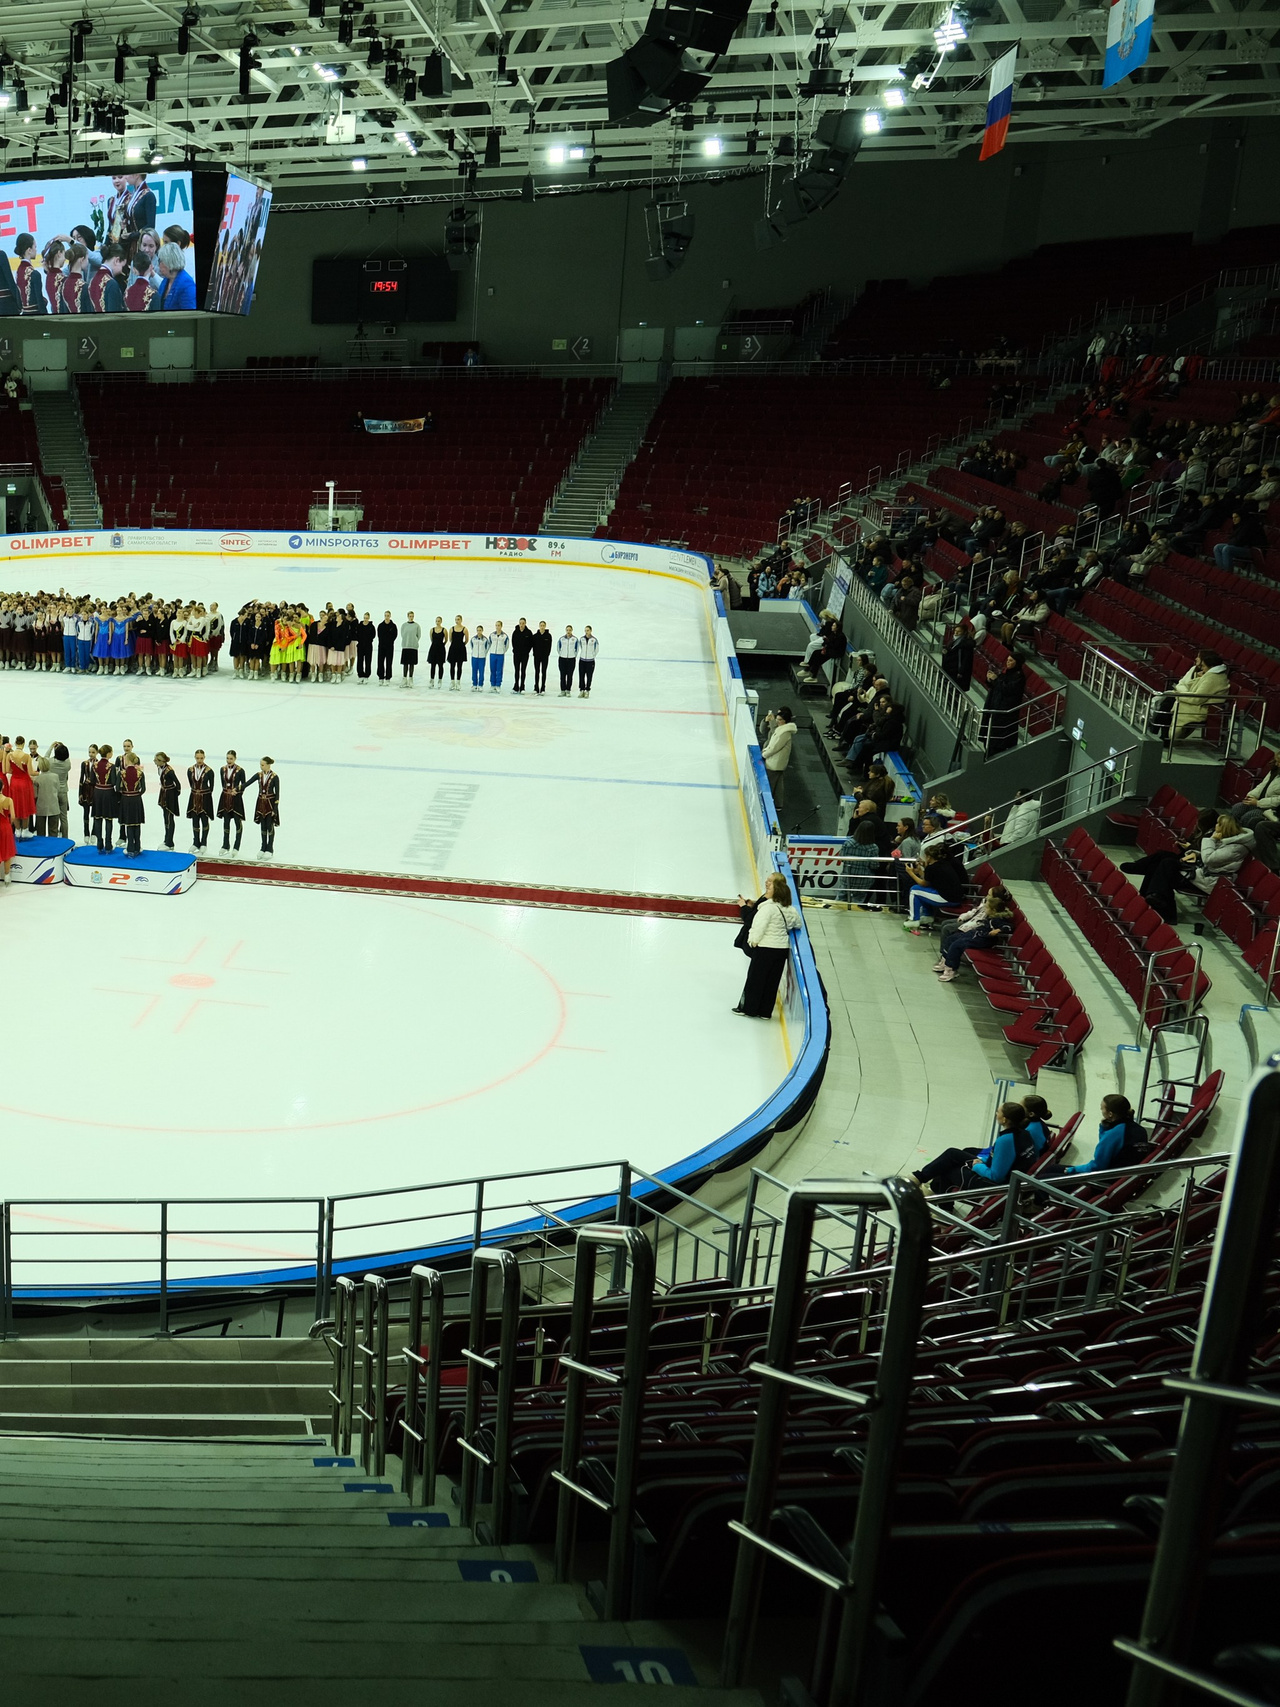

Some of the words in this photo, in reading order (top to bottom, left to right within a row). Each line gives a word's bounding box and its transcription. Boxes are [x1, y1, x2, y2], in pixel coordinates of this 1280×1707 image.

[374, 281, 398, 292] 19:54
[4, 339, 9, 350] 1
[82, 338, 88, 349] 2
[582, 338, 589, 349] 2
[745, 337, 752, 348] 3
[10, 536, 94, 550] OLIMPBET
[305, 538, 379, 548] MINSPORT63
[388, 539, 472, 550] OLIMPBET
[548, 541, 565, 549] 89.6
[615, 550, 638, 562] БУРЭНЕРГО
[108, 873, 130, 885] 2
